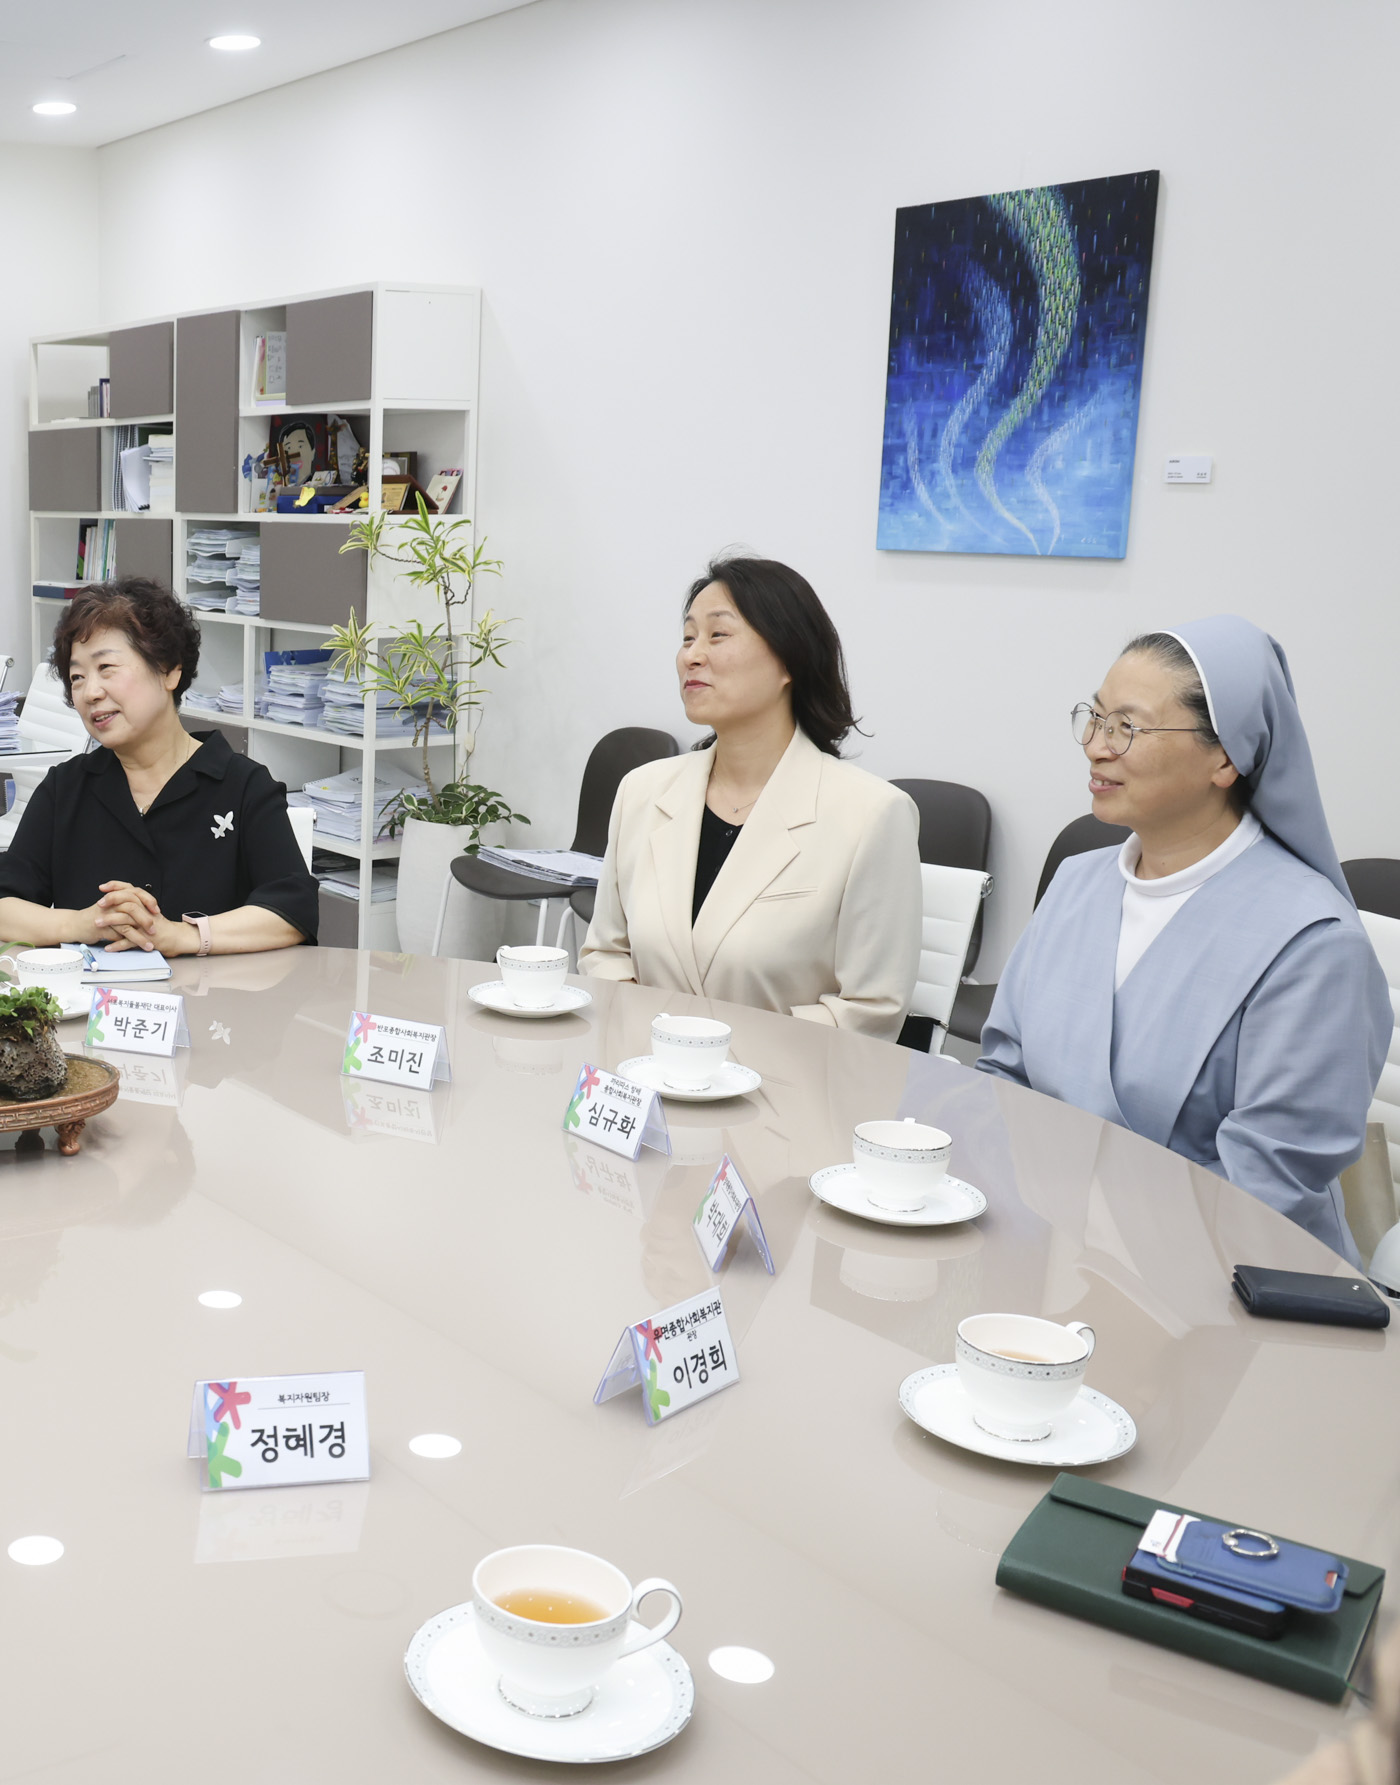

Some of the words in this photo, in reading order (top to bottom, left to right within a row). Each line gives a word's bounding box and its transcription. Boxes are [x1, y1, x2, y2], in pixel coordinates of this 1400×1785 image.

[153, 1003, 178, 1013] 대표이사
[113, 1016, 168, 1042] 박준기
[377, 1024, 437, 1042] 반포종합사회복지관장
[367, 1045, 424, 1075] 조미진
[588, 1102, 636, 1140] 심규화
[653, 1299, 722, 1344] 우면종합사회복지관
[686, 1330, 698, 1342] 관장
[673, 1340, 728, 1389] 이경희
[277, 1391, 330, 1405] 복지자원팀장
[250, 1421, 346, 1463] 정혜경
